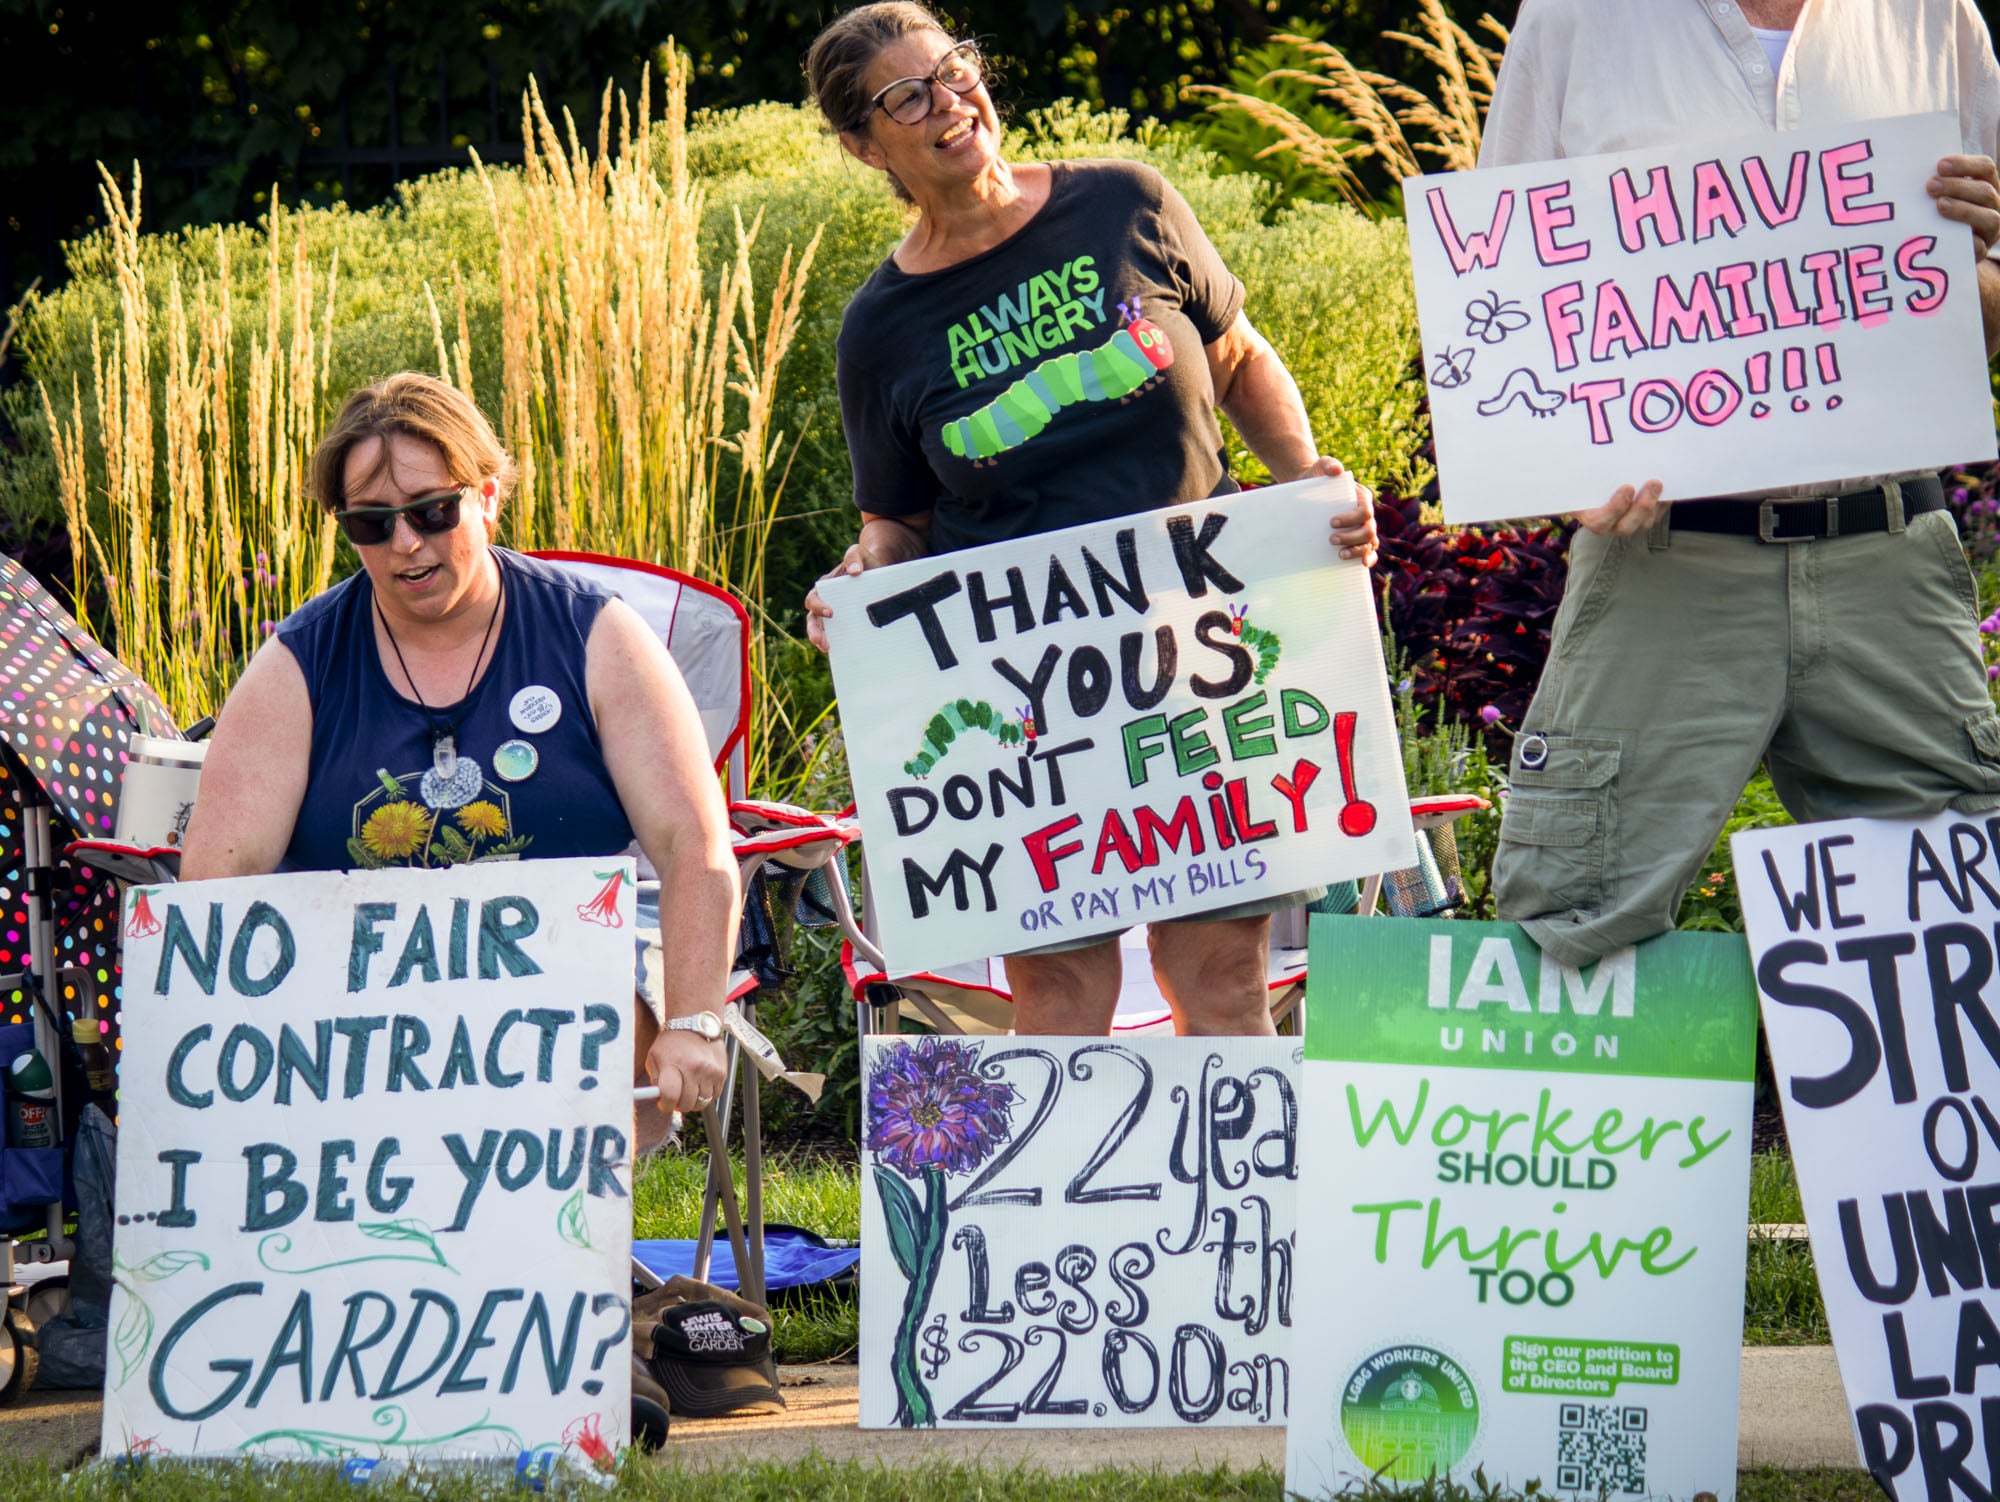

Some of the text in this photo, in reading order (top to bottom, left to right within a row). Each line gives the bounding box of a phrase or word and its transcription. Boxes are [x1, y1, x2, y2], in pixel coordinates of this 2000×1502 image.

[1425, 138, 1895, 278] WE HAVE
[947, 255, 1100, 362] ALWAYS
[950, 286, 1108, 389] HUNGRY
[1540, 234, 1950, 373] FAMILIES
[1569, 341, 1845, 446] TOO!!!
[866, 512, 1246, 672] THANK
[885, 688, 1331, 837] DON'T FEED
[902, 843, 1005, 919] MY
[1020, 848, 1267, 931] OR PAY MY BILLS
[1761, 834, 1866, 933] WE
[154, 895, 545, 997] NO FAIR
[1426, 933, 1637, 1018] IAM
[166, 1003, 620, 1110] CONTRACT?
[1440, 1026, 1620, 1059] UNION
[1757, 921, 2000, 1110] STR
[949, 1043, 1162, 1212] 22
[1345, 1077, 1732, 1169] Workers
[1436, 1150, 1617, 1190] SHOULD
[239, 1136, 415, 1232] BEG
[434, 1124, 629, 1232] YOUR
[952, 1195, 1296, 1335] Less th
[1351, 1197, 1698, 1279] Thrive
[1469, 1266, 1575, 1308] TOO
[148, 1281, 631, 1420] GARDEN?
[680, 1312, 723, 1327] LEWIS
[687, 1330, 756, 1341] BOTANICAL
[689, 1339, 744, 1350] GARDEN
[1510, 1341, 1674, 1363] Sign our petition to
[1510, 1357, 1673, 1379] the CEO and Board
[1346, 1348, 1475, 1409] LGBG WORKERS UNITED
[1509, 1374, 1610, 1392] of Directors
[1855, 1397, 2000, 1502] PR
